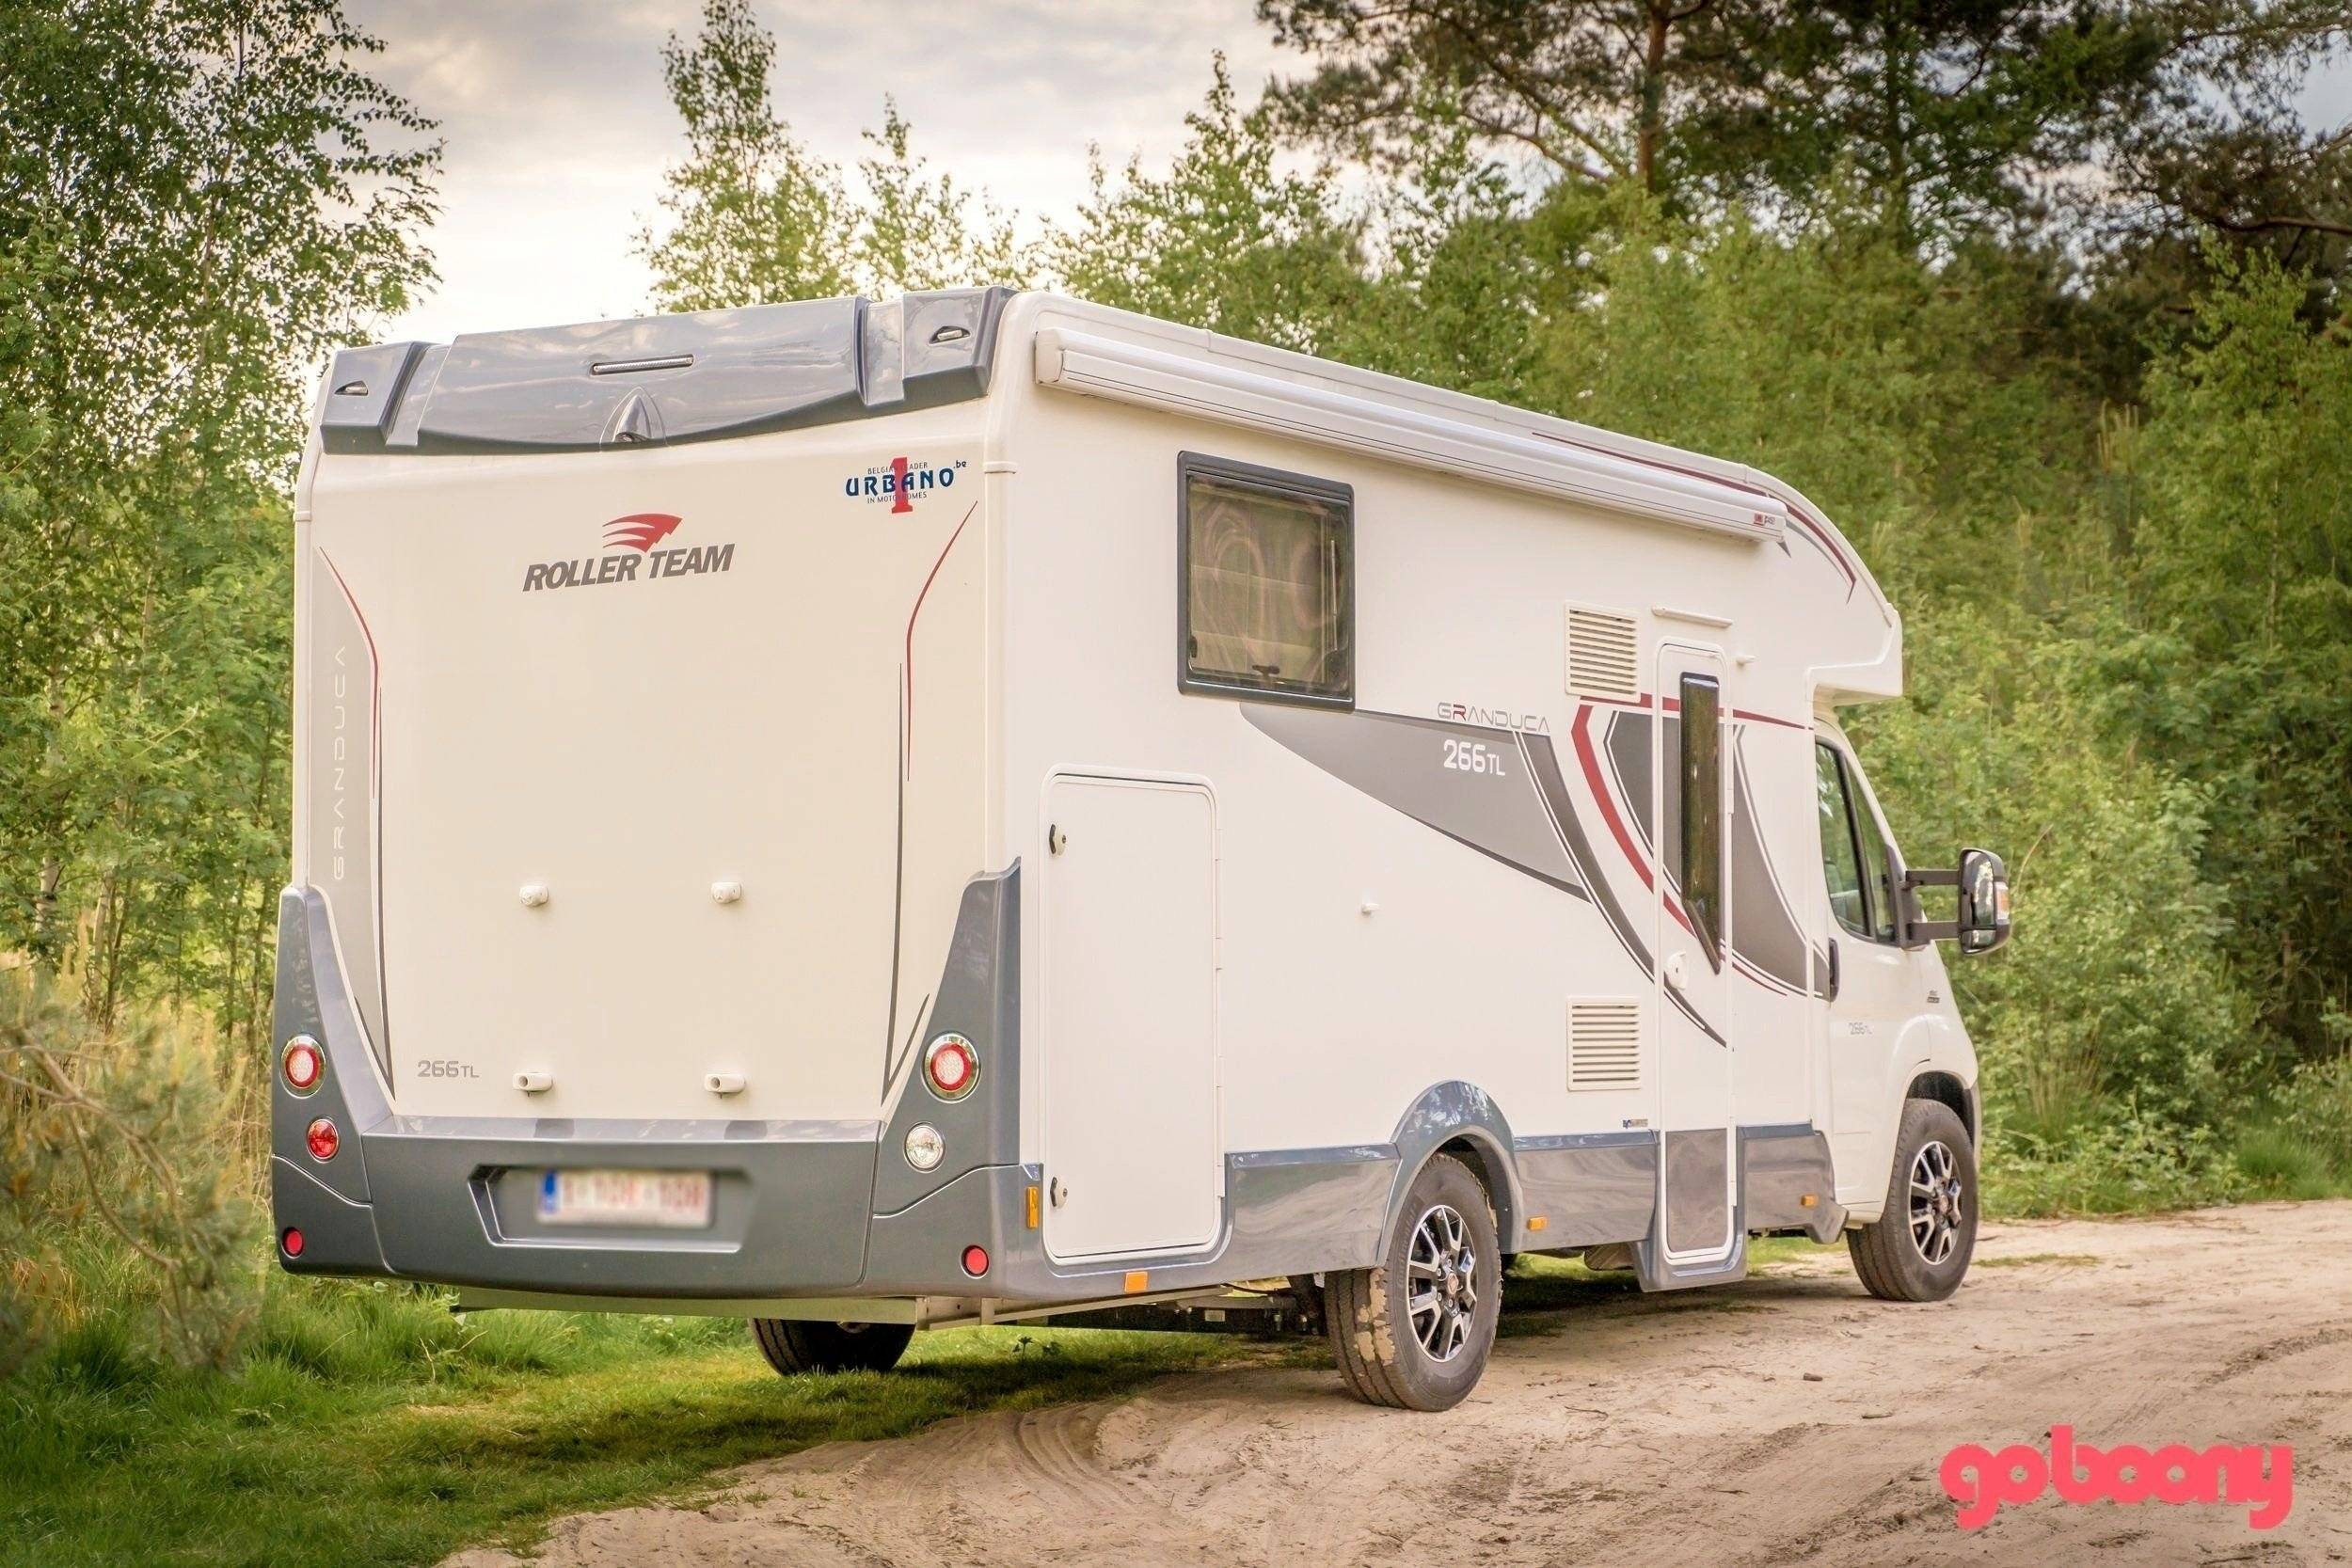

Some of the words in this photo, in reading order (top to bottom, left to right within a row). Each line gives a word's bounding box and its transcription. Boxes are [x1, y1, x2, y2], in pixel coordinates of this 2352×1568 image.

[867, 465, 898, 475] BELGIA
[901, 461, 929, 471] ADER
[877, 491, 928, 503] MOTOOMES
[522, 553, 642, 592] ROLLER
[649, 544, 735, 578] TEAM
[1438, 702, 1550, 732] GRANDUCA
[333, 646, 346, 880] GRANDUCA
